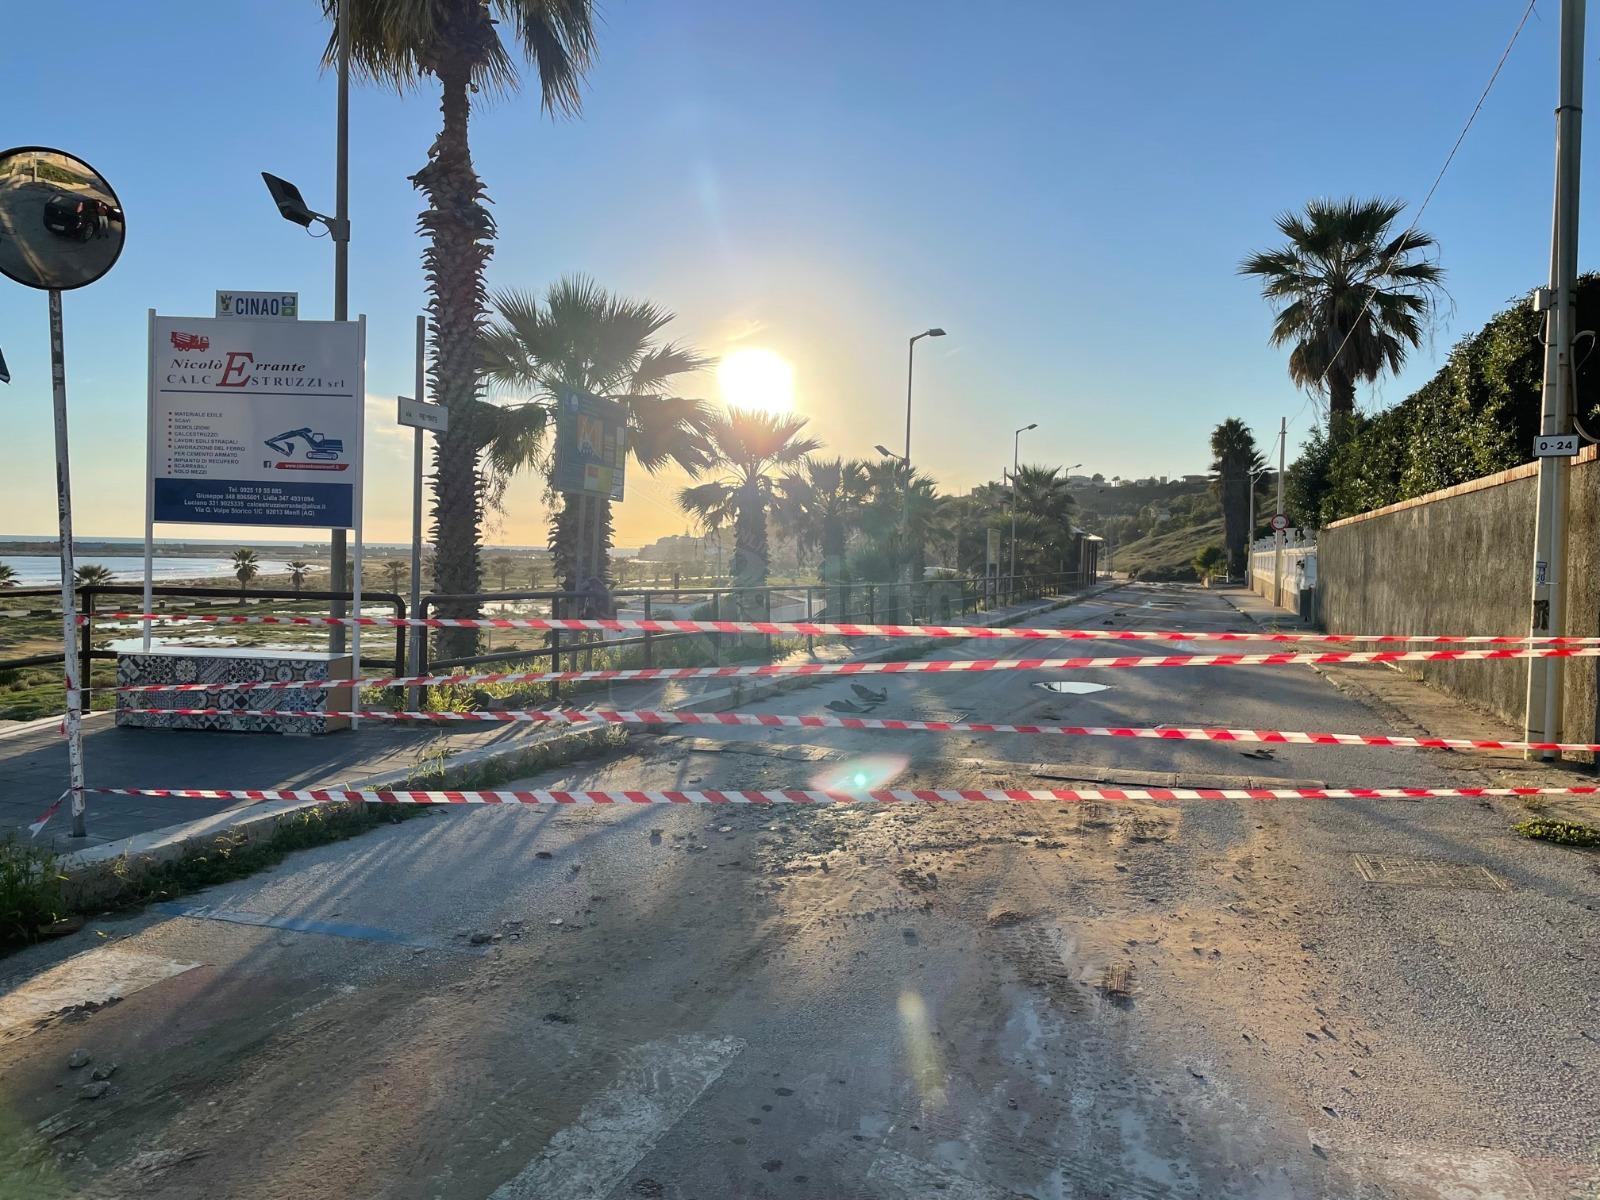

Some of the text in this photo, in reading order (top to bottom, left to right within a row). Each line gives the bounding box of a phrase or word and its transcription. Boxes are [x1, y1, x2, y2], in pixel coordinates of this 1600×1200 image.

[236, 298, 278, 315] CINAO
[170, 358, 222, 370] Nicolò
[328, 380, 344, 388] srl
